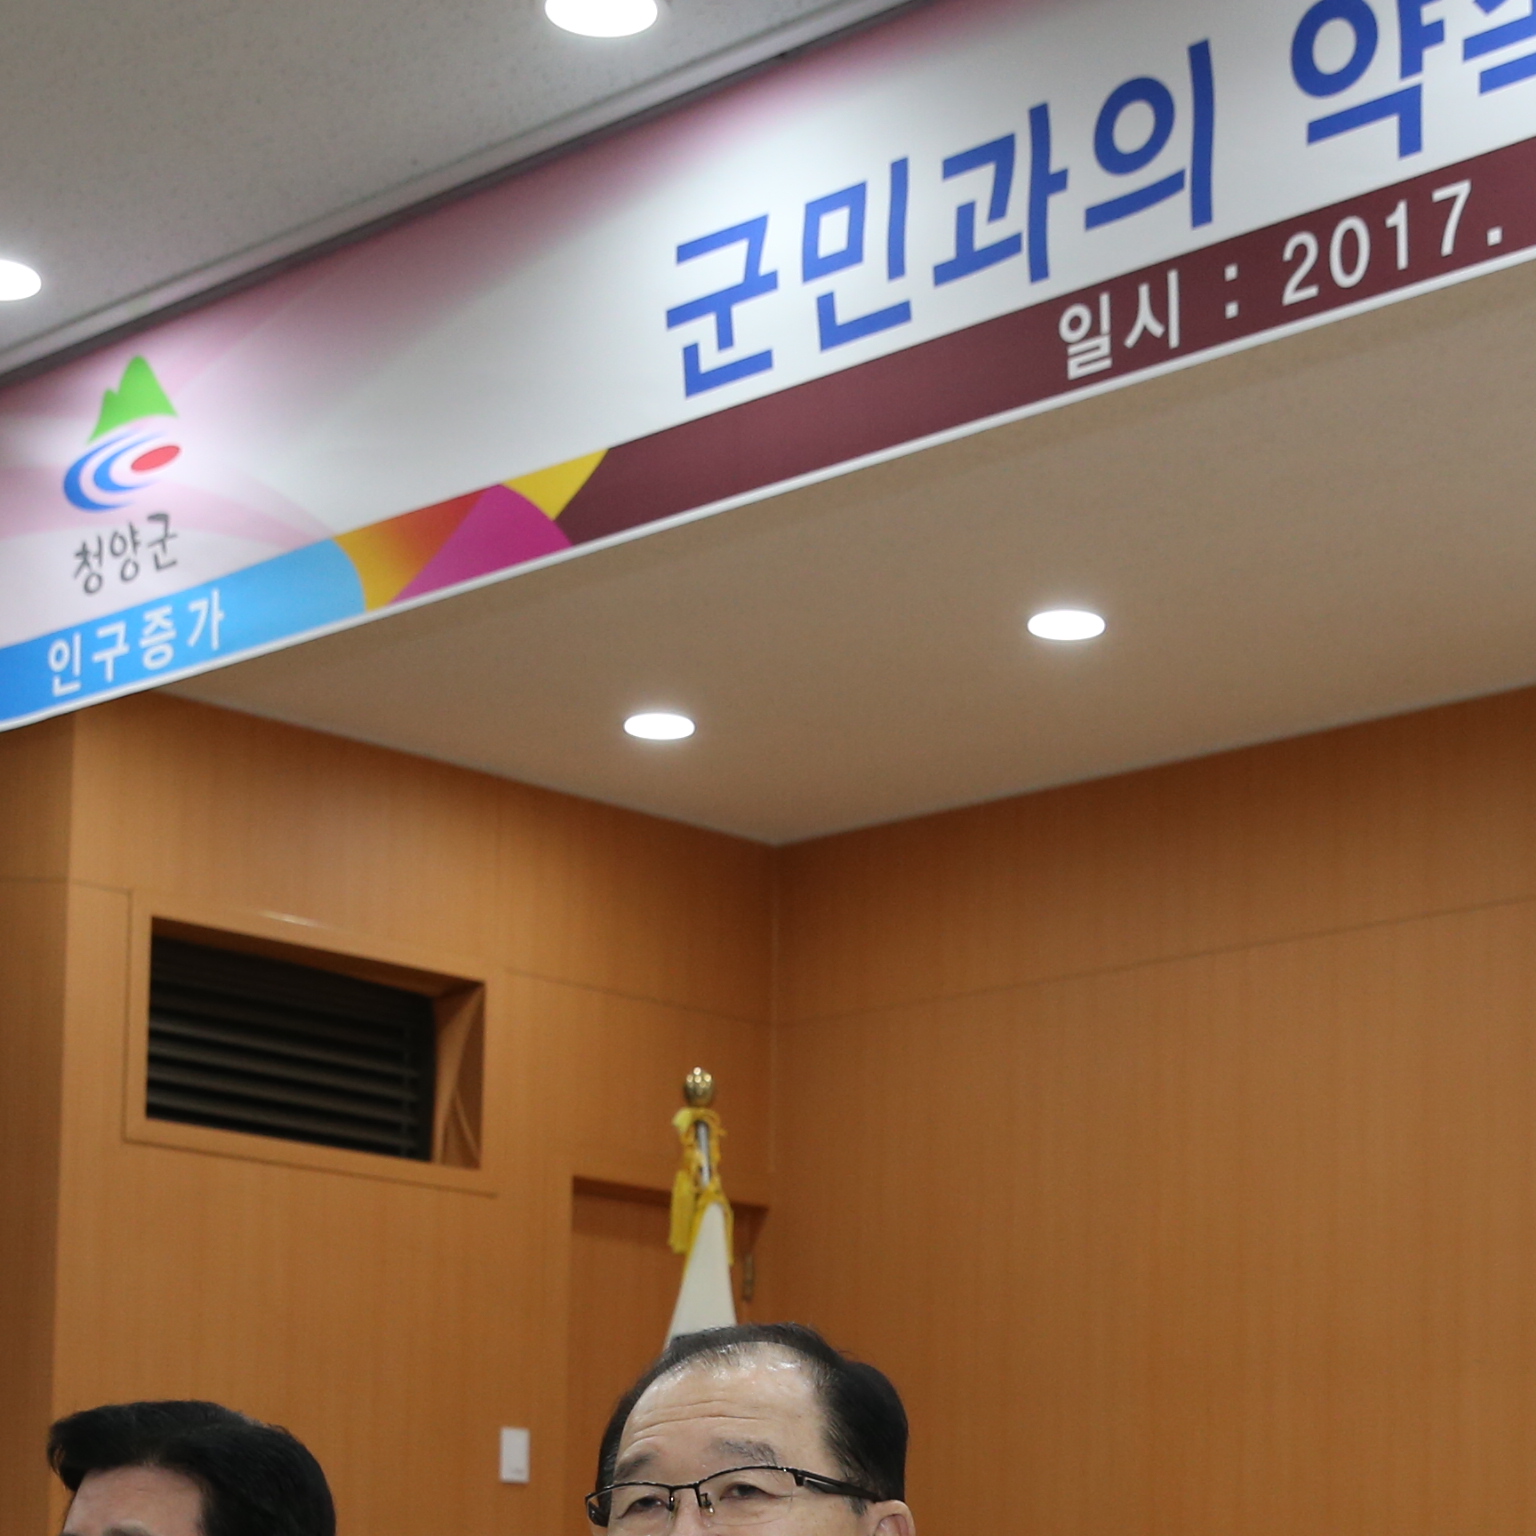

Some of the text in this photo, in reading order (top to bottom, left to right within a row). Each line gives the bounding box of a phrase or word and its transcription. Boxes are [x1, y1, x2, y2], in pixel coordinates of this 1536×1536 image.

[664, 40, 1216, 397] 군민과의
[1058, 270, 1181, 380] 일시
[1281, 181, 1503, 307] 2017.
[74, 511, 178, 595] 청양군
[48, 588, 225, 697] 인구증가
